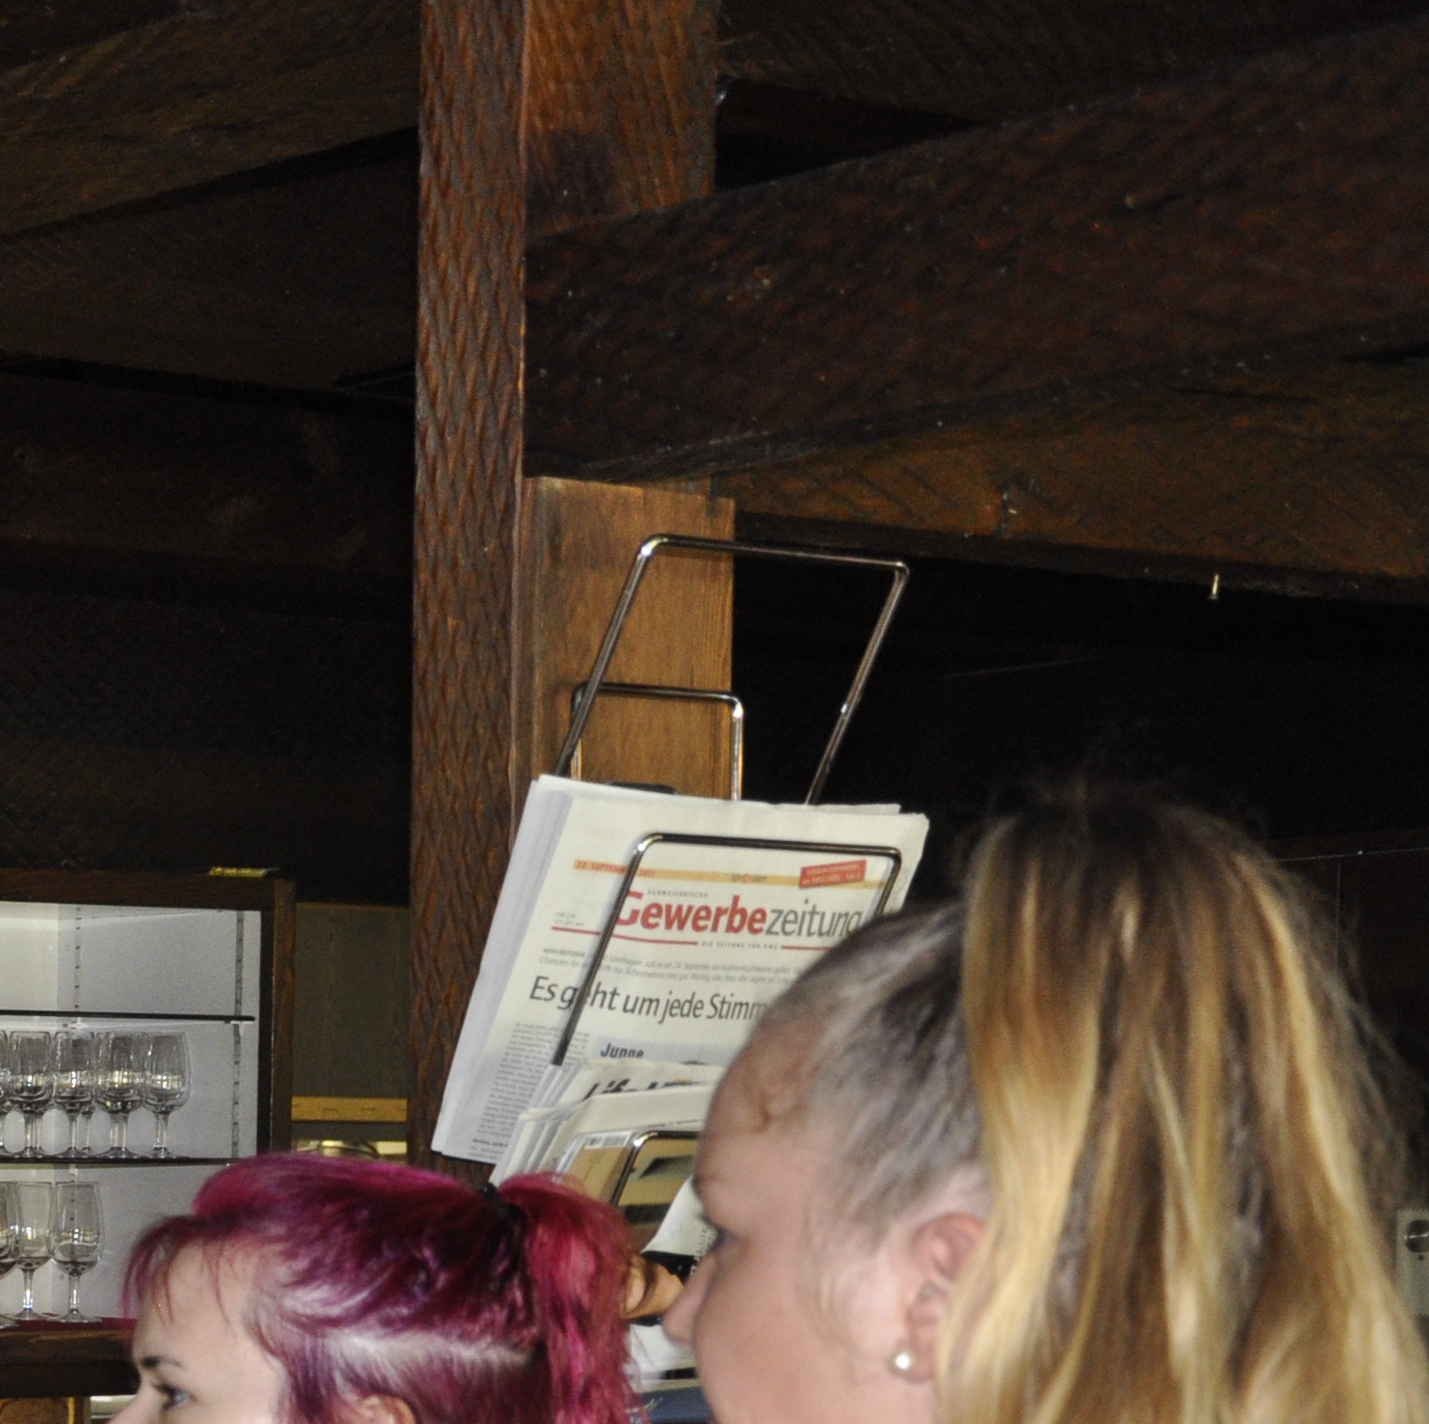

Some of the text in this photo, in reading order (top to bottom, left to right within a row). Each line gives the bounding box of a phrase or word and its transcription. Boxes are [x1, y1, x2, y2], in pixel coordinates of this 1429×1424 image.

[529, 975, 768, 1025] Es ght um jede Stimm
